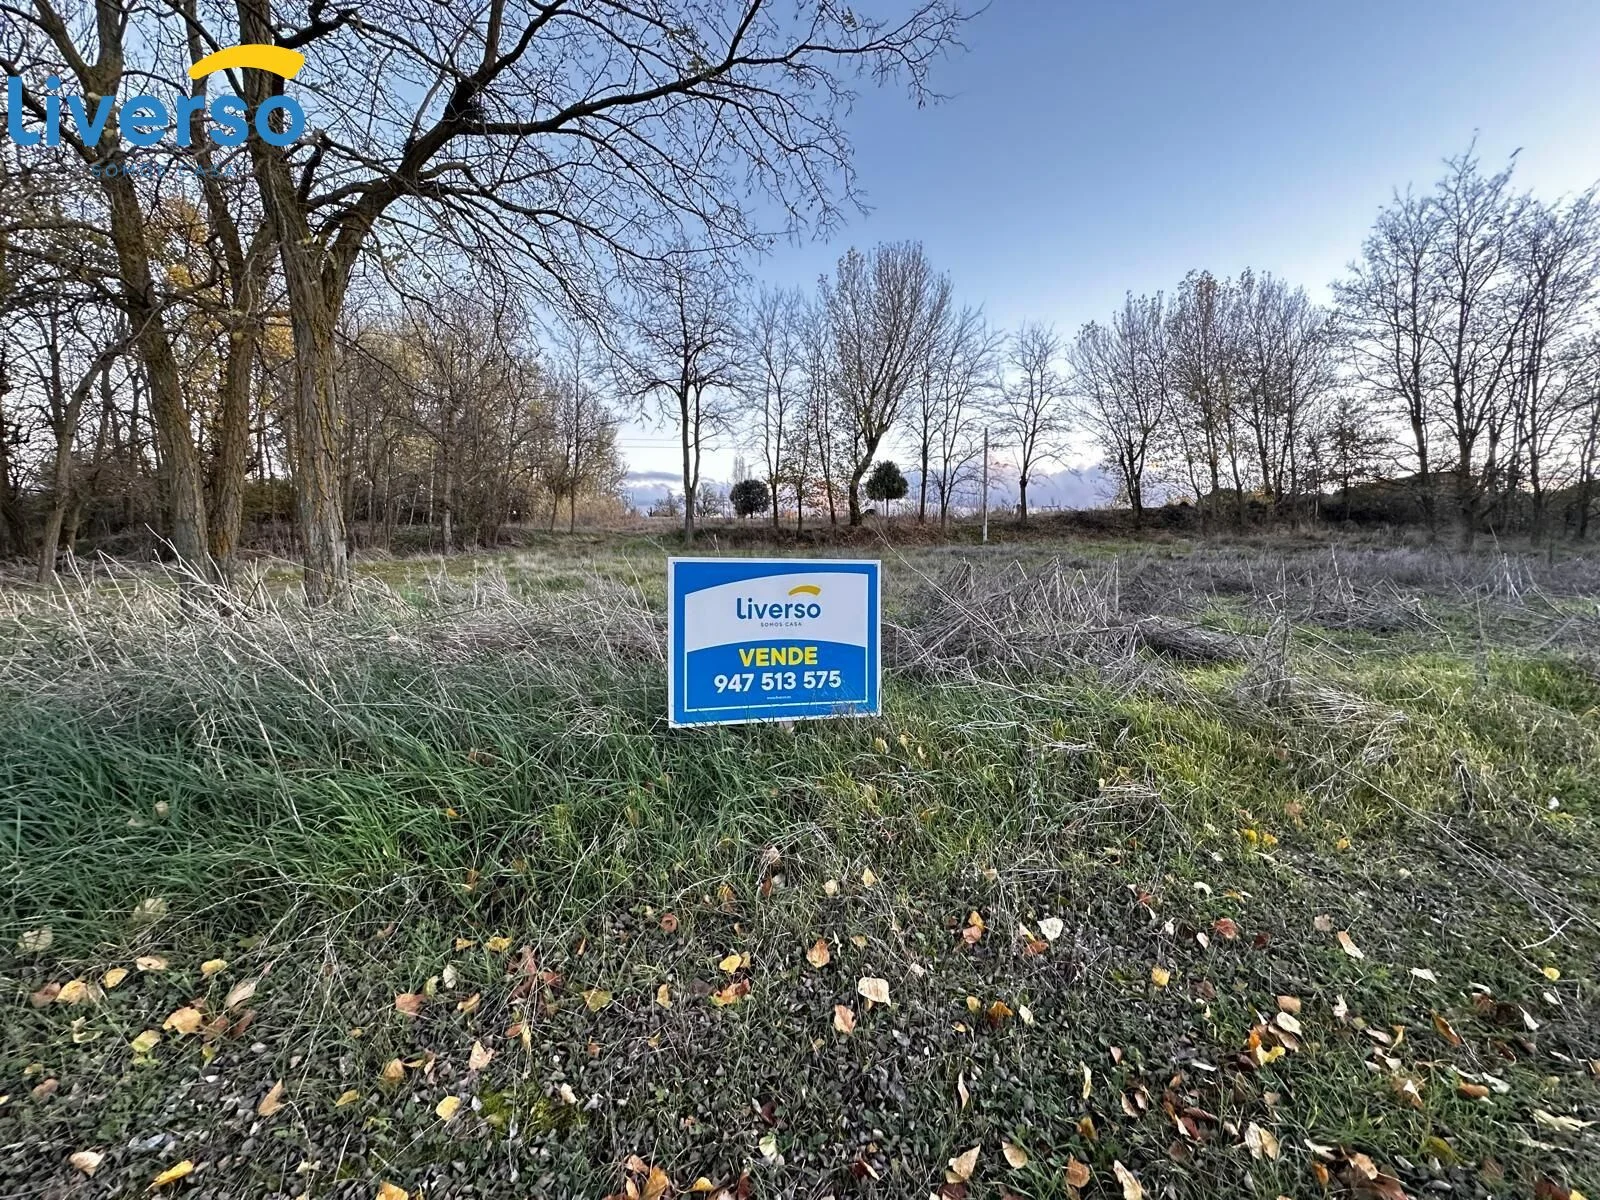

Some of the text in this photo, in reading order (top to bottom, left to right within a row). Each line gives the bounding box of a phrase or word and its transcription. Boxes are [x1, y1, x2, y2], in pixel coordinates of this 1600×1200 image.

[738, 646, 818, 667] VENDE
[713, 670, 842, 694] 947 513 575
